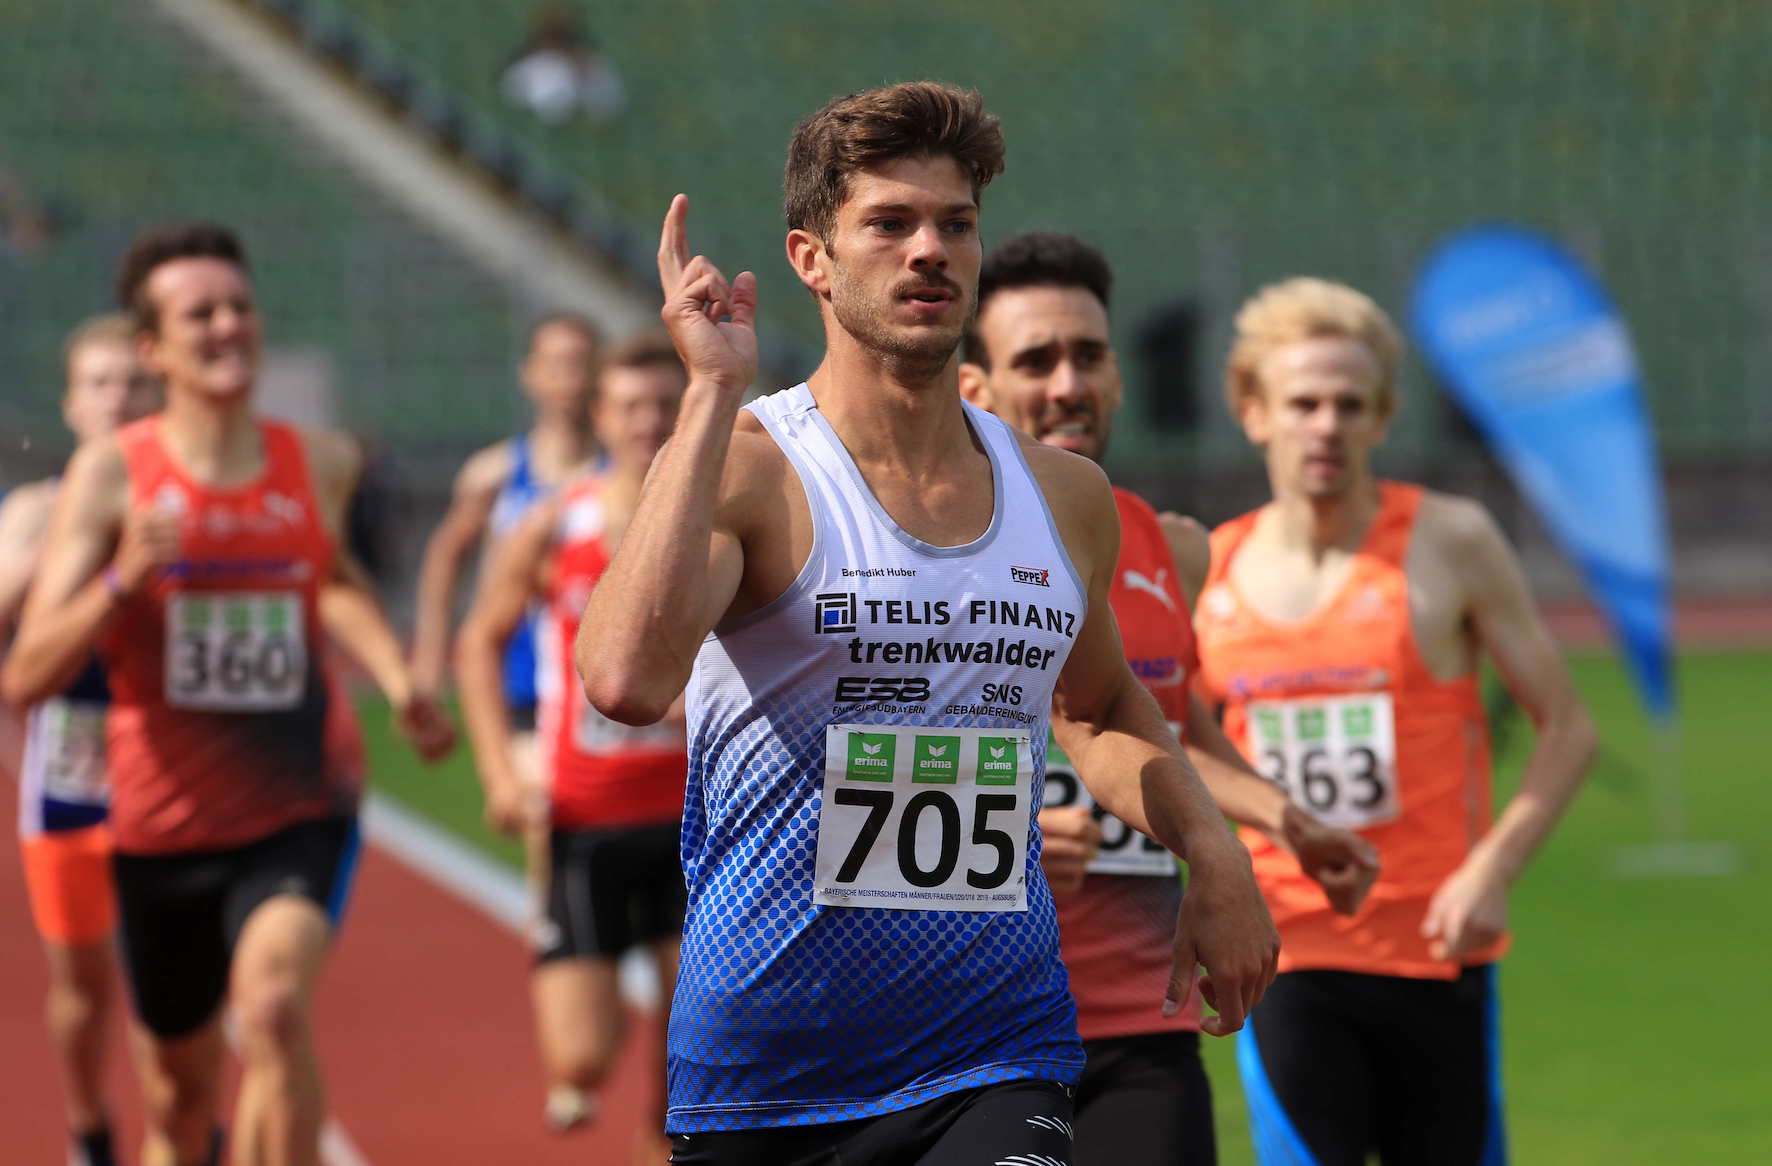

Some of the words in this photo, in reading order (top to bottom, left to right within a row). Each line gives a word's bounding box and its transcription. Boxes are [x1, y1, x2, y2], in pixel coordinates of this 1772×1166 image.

[841, 568, 885, 577] Benedikt
[887, 568, 917, 577] Huber
[864, 600, 950, 625] TELIS
[969, 600, 1076, 638] FINANZ
[178, 635, 292, 694] 360
[848, 637, 1055, 671] trenkwalder
[834, 677, 930, 702] ESB
[981, 683, 1023, 706] SNS
[854, 756, 888, 767] erima
[919, 758, 952, 769] erima
[983, 760, 1012, 770] erima
[834, 788, 1017, 889] 705
[824, 887, 857, 896] BAYERISCHE
[858, 889, 908, 898] MEISTERSCHAFTEN
